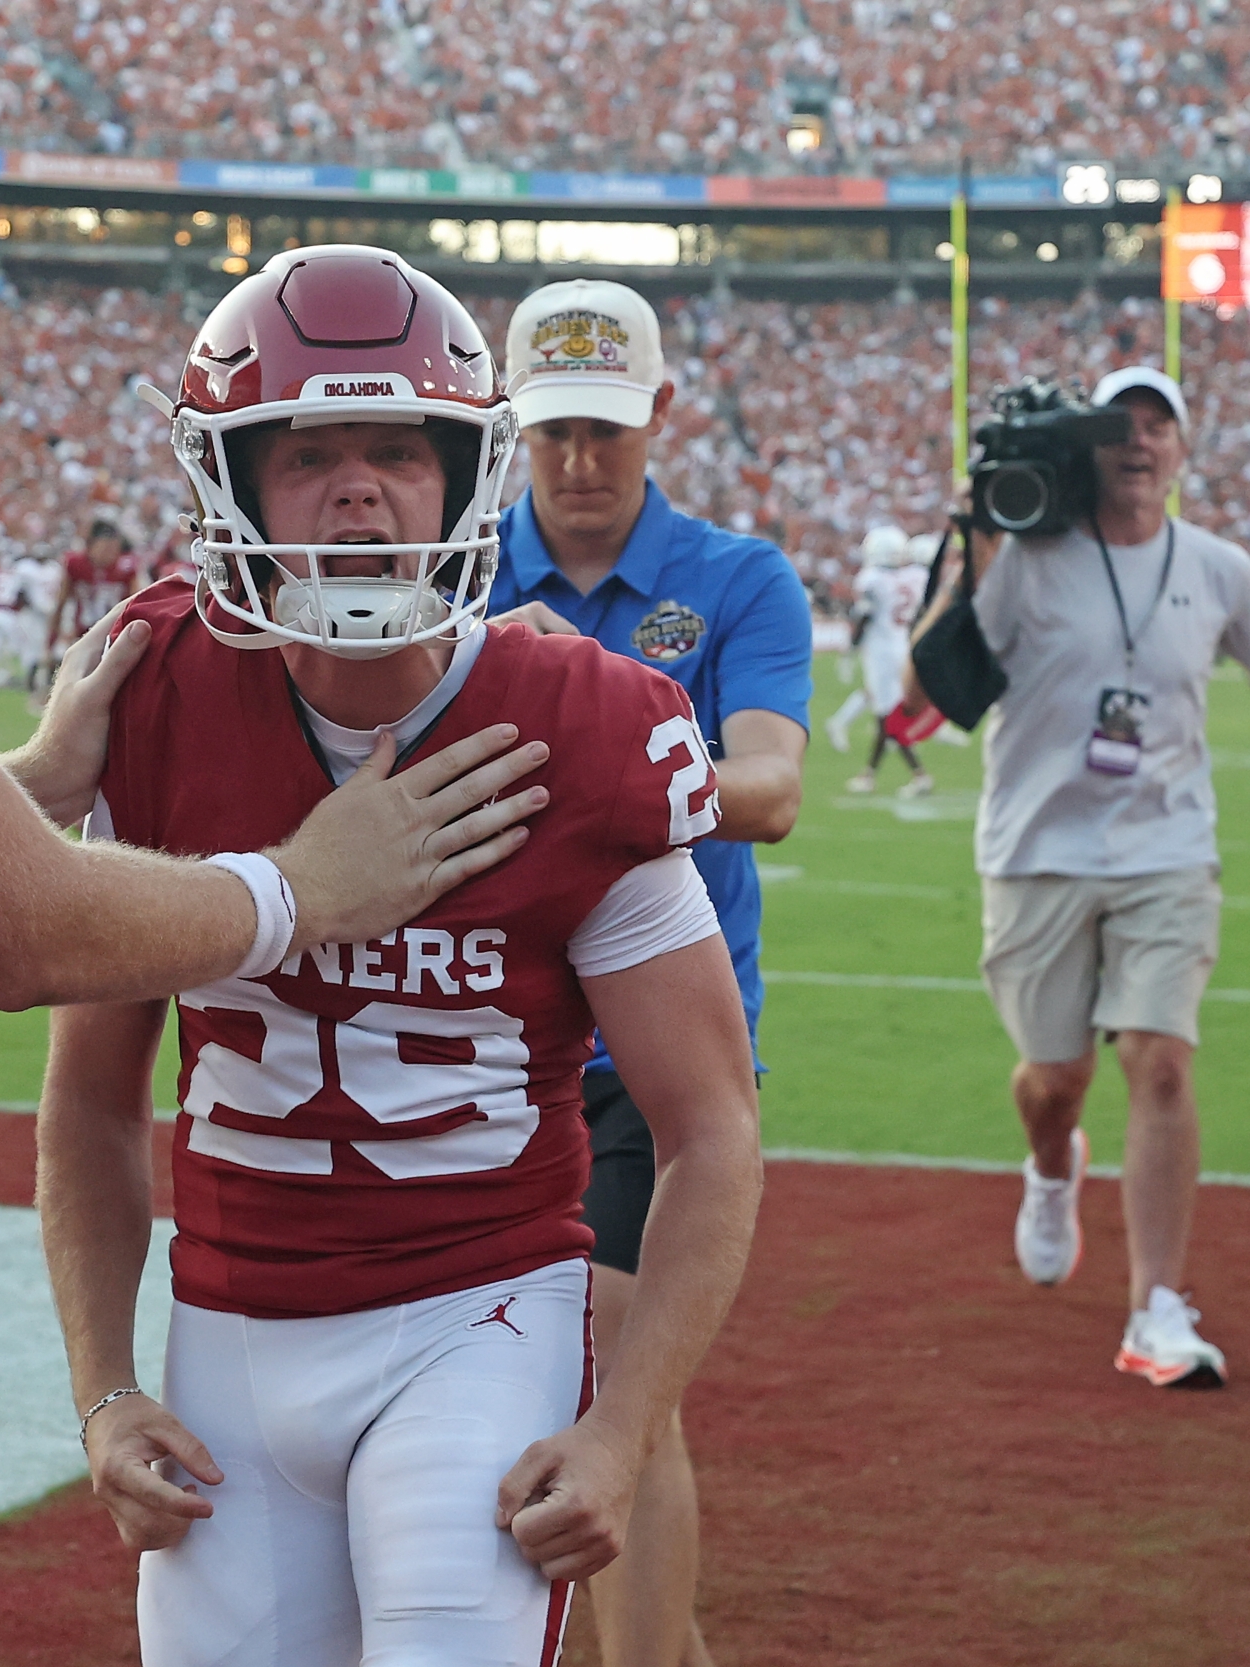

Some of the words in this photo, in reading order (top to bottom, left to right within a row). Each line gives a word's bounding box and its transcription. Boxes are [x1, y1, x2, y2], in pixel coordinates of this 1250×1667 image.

[324, 382, 395, 397] OKLAHOMA
[646, 702, 723, 846] 2
[280, 927, 508, 995] NERS
[177, 976, 540, 1180] 29
